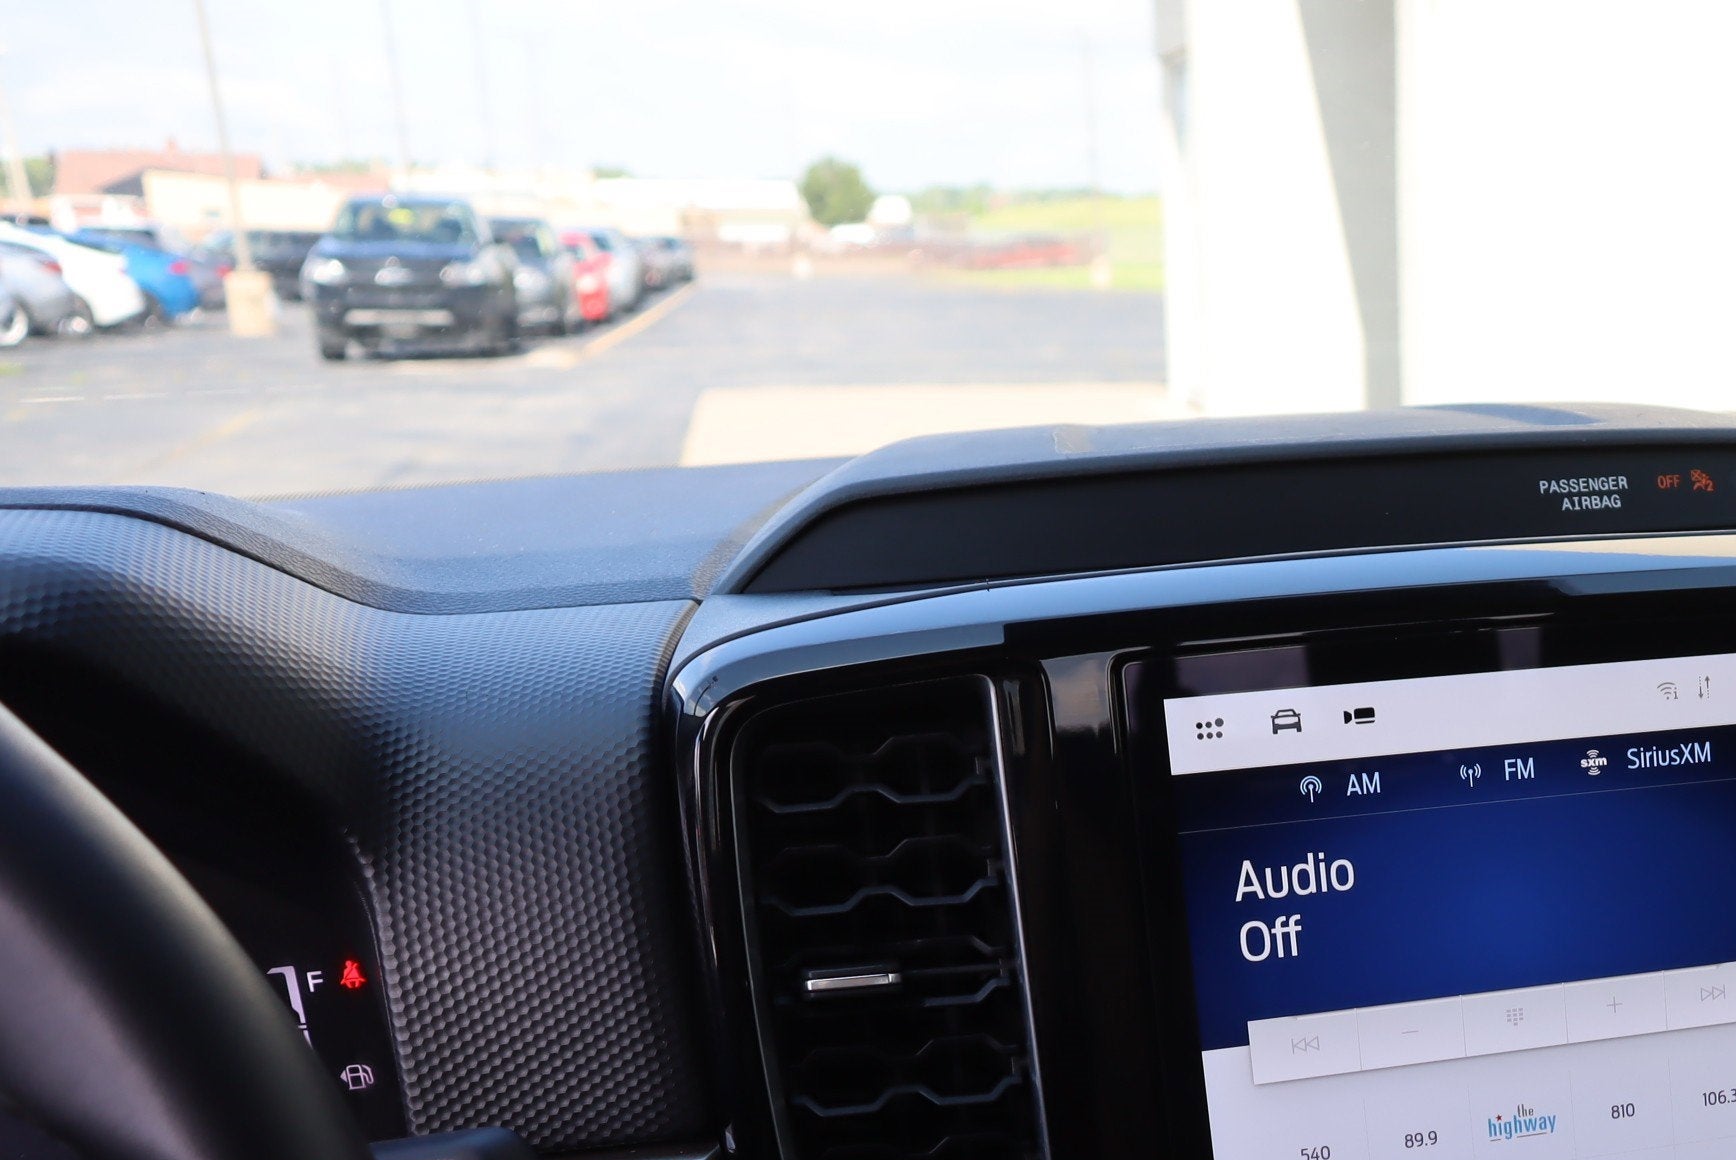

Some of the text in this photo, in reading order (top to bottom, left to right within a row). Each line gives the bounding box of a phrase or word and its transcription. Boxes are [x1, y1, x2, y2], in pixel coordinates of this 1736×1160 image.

[1539, 475, 1629, 494] PASSENGER
[1657, 474, 1681, 489] OFF
[1561, 494, 1622, 511] AIRBAG
[1627, 741, 1711, 769] SiriusXM
[1504, 757, 1536, 781] FM
[1346, 771, 1382, 797] AM
[1235, 852, 1355, 902] Audio
[1239, 914, 1302, 962] Off
[306, 970, 324, 992] F
[1517, 1103, 1534, 1118] the
[1611, 1102, 1635, 1120] 810
[1487, 1114, 1557, 1140] highway
[1404, 1130, 1438, 1149] 89.9
